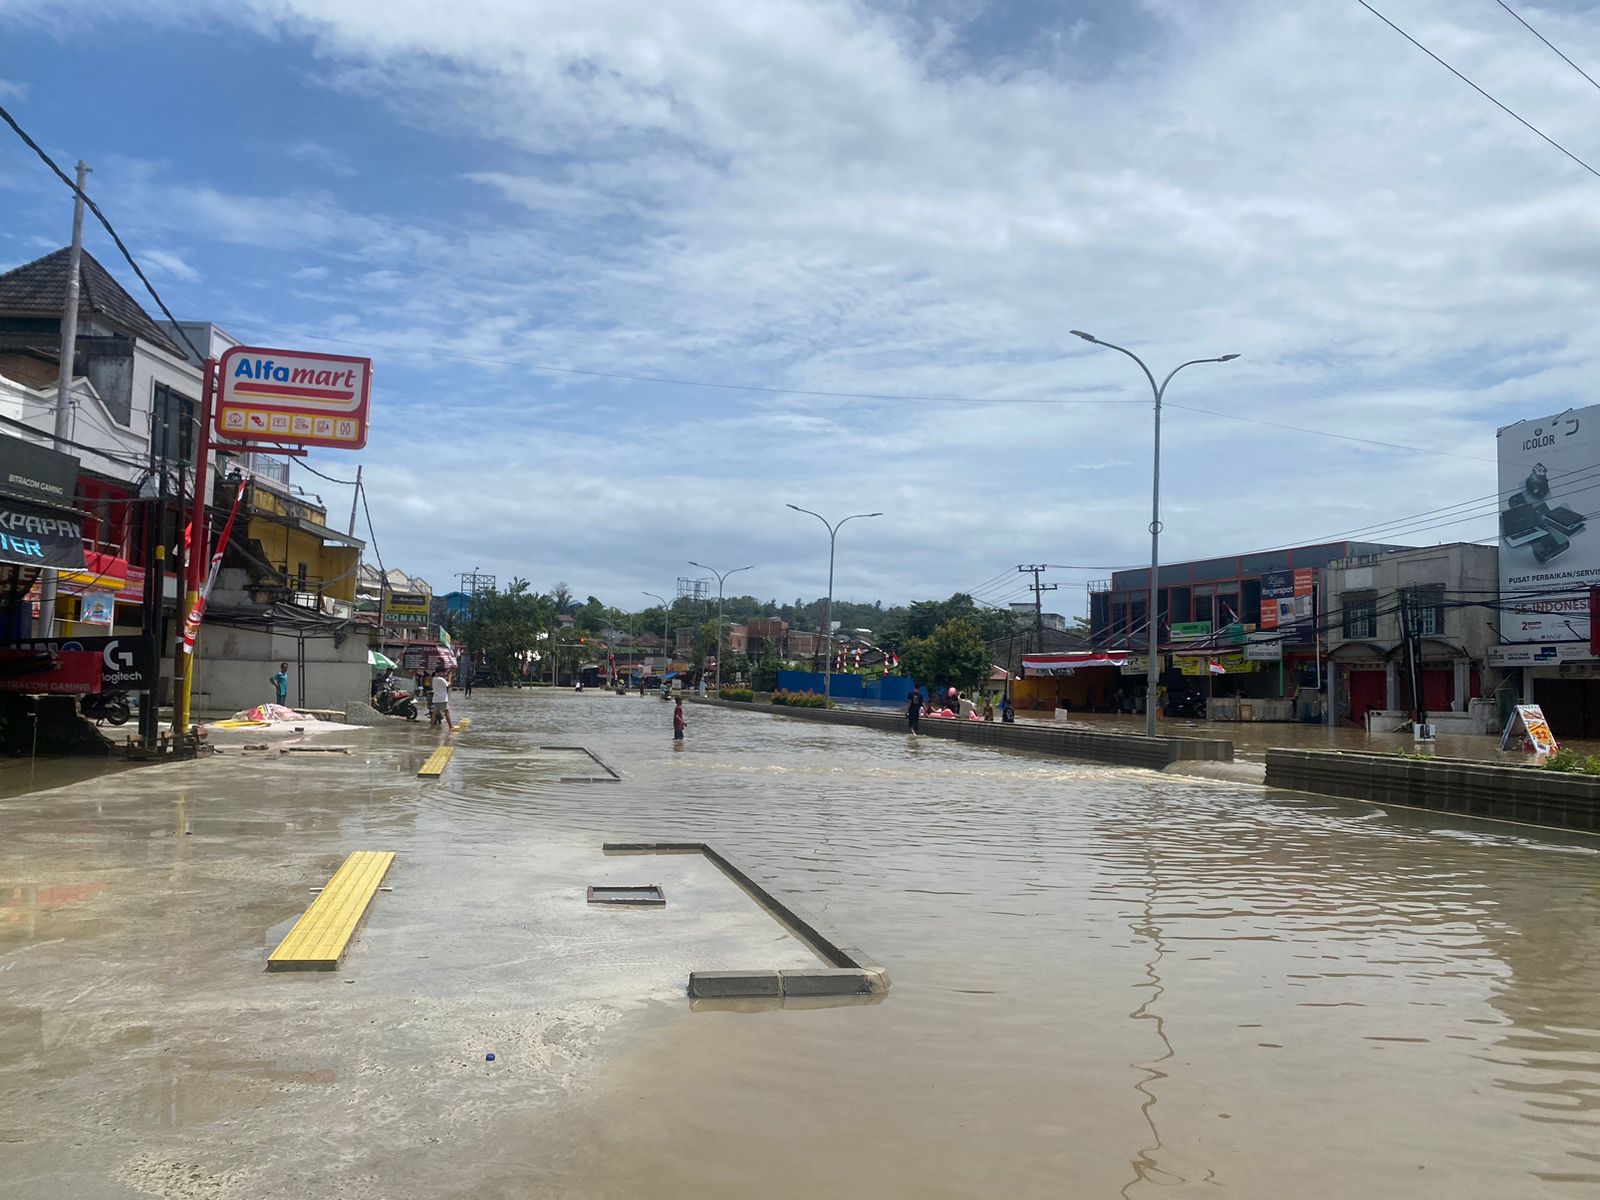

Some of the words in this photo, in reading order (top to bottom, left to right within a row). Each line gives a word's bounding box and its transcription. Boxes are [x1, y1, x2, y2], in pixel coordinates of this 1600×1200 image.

[234, 358, 357, 388] Alfamart
[1522, 434, 1556, 451] iCOLOR
[8, 473, 40, 489] BITRACOM
[40, 482, 64, 495] GAMING
[1508, 575, 1531, 584] PUSAT
[400, 614, 427, 623] MAXI
[102, 672, 143, 685] logitech
[50, 682, 92, 691] GAMING
